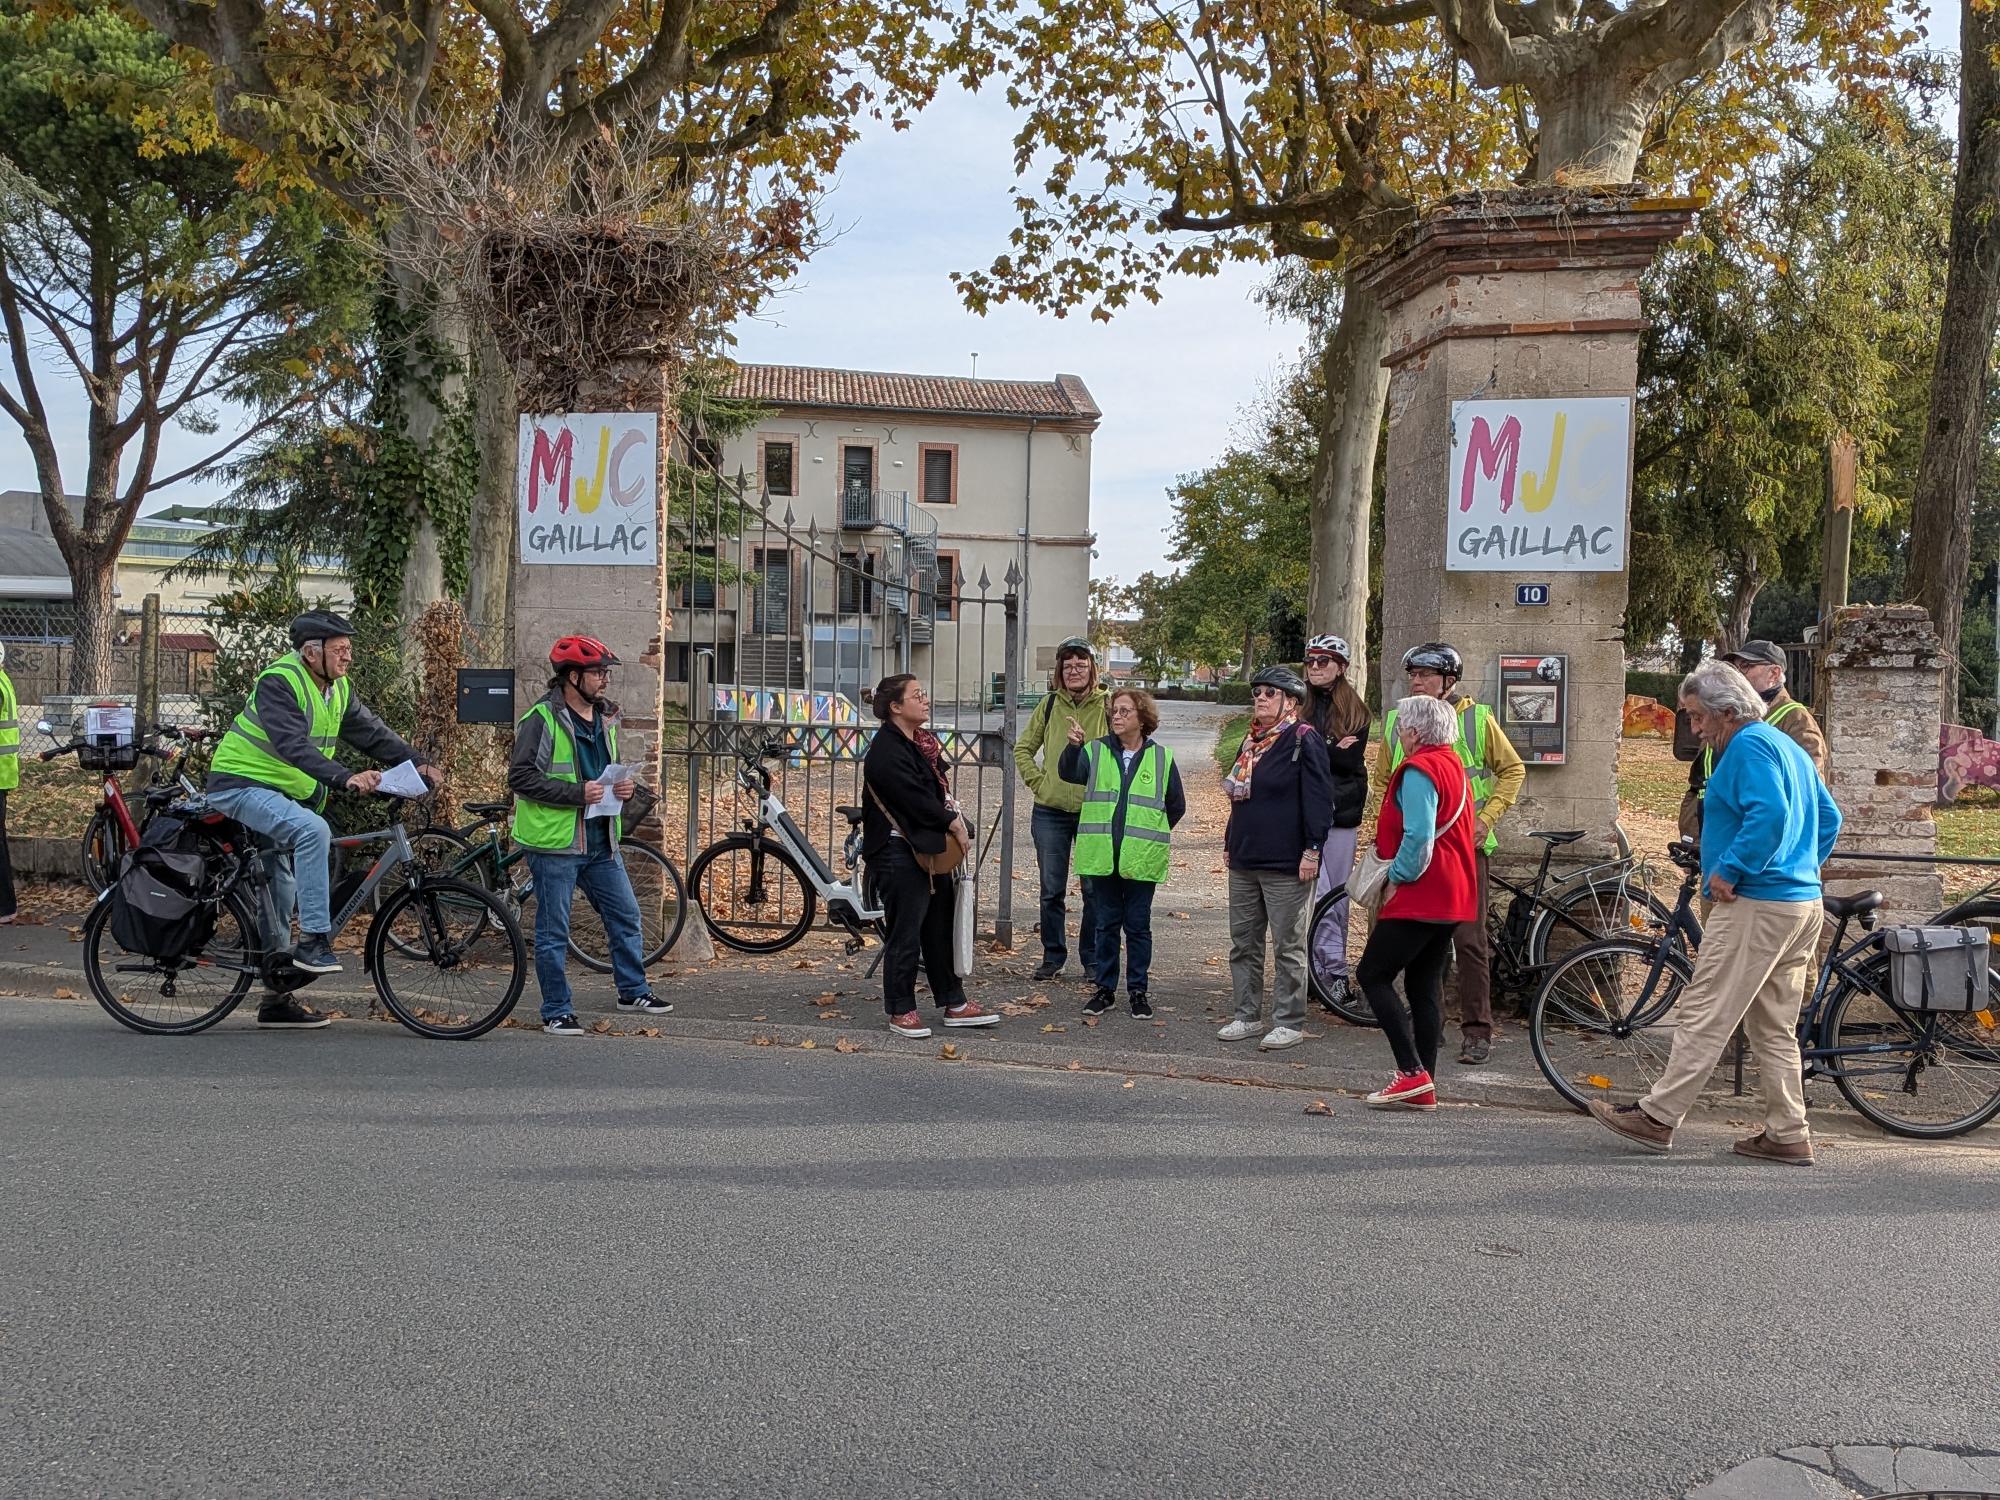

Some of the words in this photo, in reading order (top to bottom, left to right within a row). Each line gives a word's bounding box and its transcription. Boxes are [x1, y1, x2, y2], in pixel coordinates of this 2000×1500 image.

[527, 425, 648, 515] MJC
[1459, 411, 1618, 514] MJC
[528, 523, 648, 556] GAILLAC
[1458, 524, 1614, 560] GAILLAC
[1523, 587, 1541, 602] 10
[335, 888, 365, 926] WINORA
